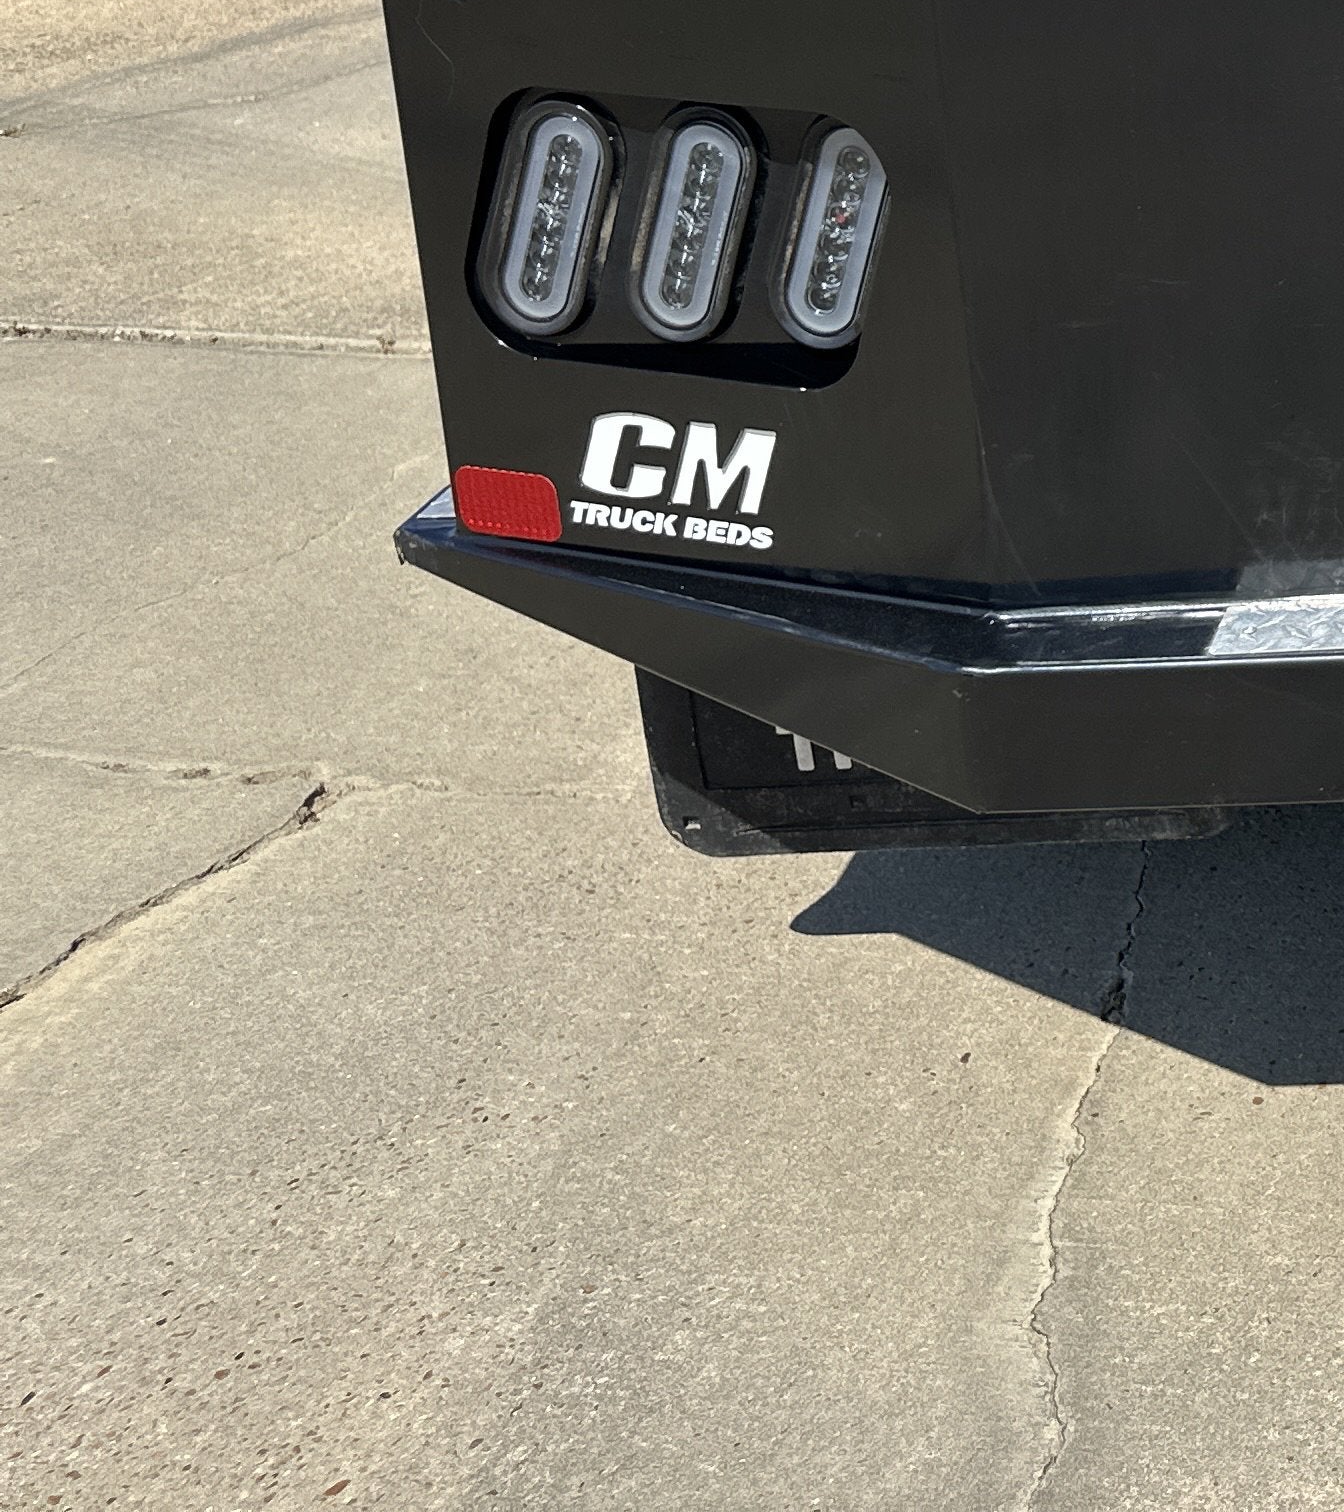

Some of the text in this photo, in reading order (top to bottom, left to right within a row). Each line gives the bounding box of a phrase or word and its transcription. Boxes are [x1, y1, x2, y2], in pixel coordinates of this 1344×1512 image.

[580, 411, 777, 515] CM
[570, 500, 774, 550] TRUCK BEDS
